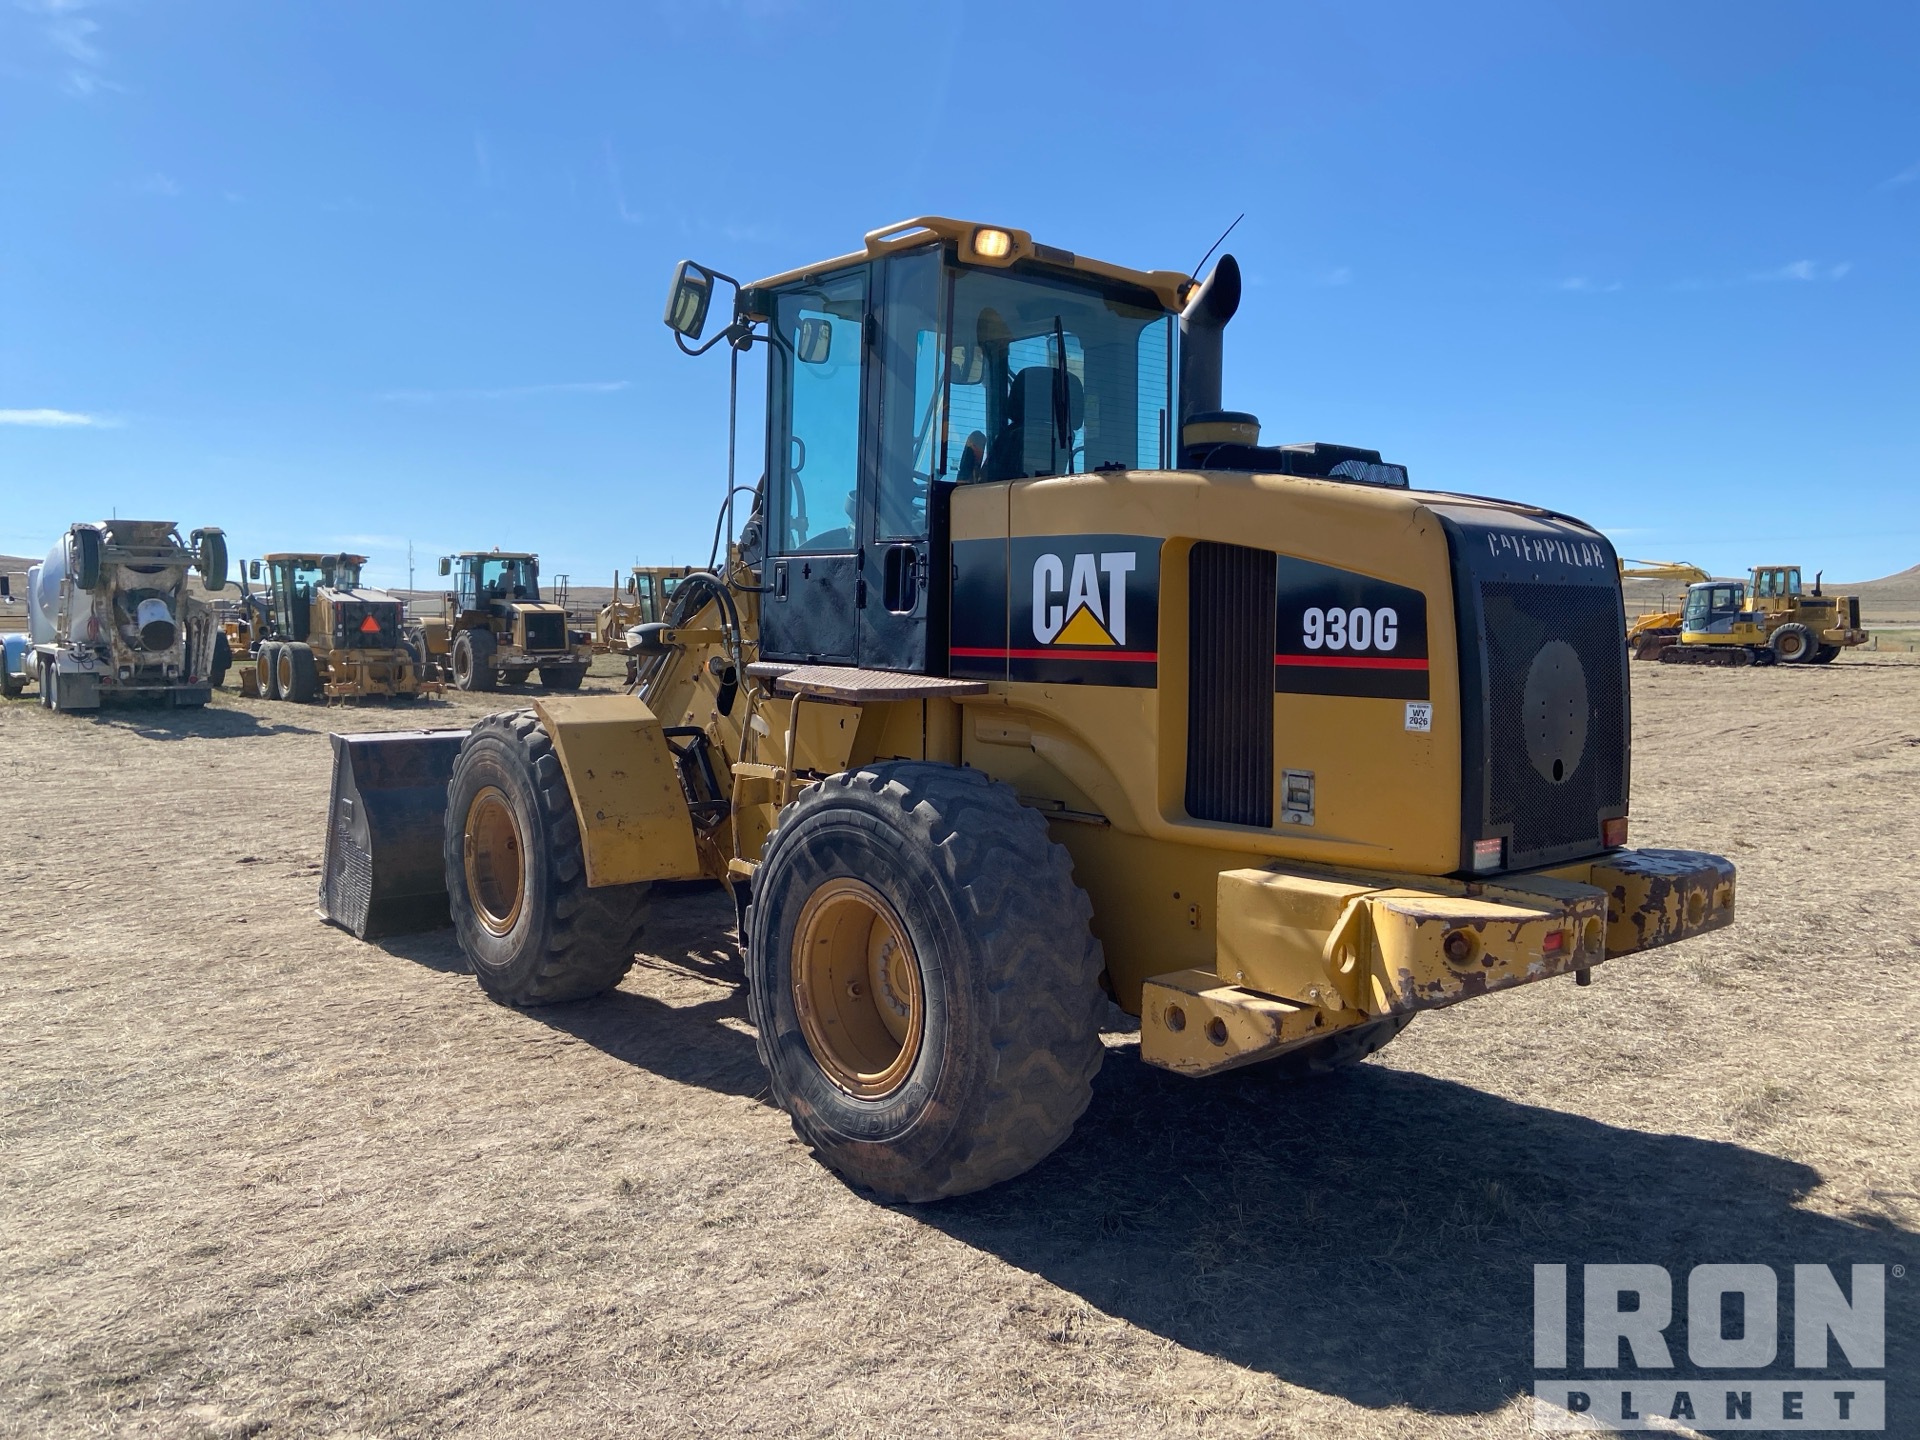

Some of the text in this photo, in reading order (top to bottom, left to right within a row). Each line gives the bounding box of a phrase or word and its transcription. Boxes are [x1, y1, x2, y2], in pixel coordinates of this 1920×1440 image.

[1487, 532, 1605, 569] CATERPILLAR
[1032, 551, 1136, 646] CAT
[1303, 607, 1398, 651] 930G
[1409, 717, 1428, 726] 2026
[1412, 709, 1426, 717] WY
